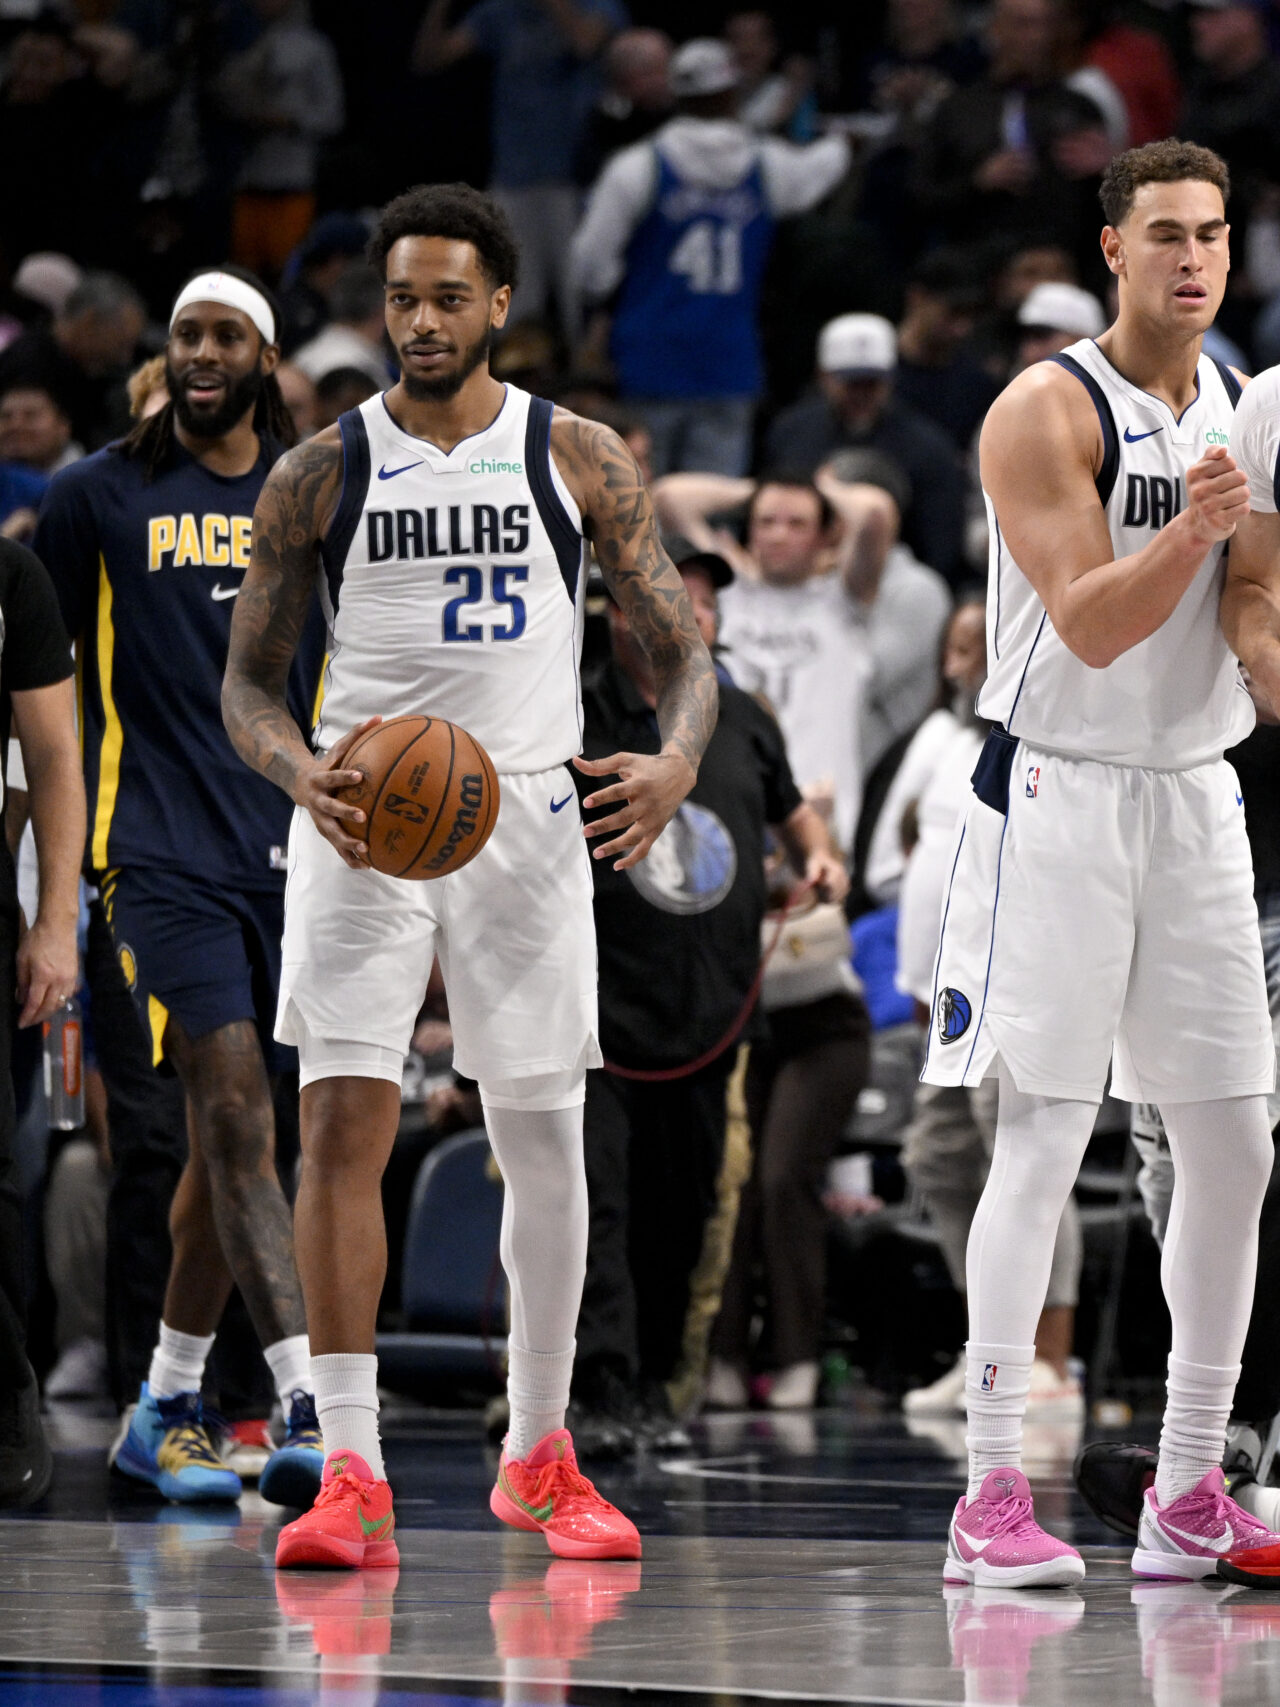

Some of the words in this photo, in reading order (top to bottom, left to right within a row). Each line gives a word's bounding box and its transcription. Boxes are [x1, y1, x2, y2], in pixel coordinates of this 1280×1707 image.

[668, 222, 741, 294] 41
[470, 459, 523, 474] chime
[148, 513, 253, 573] PACE
[366, 504, 530, 565] DALLAS
[442, 564, 530, 644] 25
[422, 773, 483, 871] Wilson
